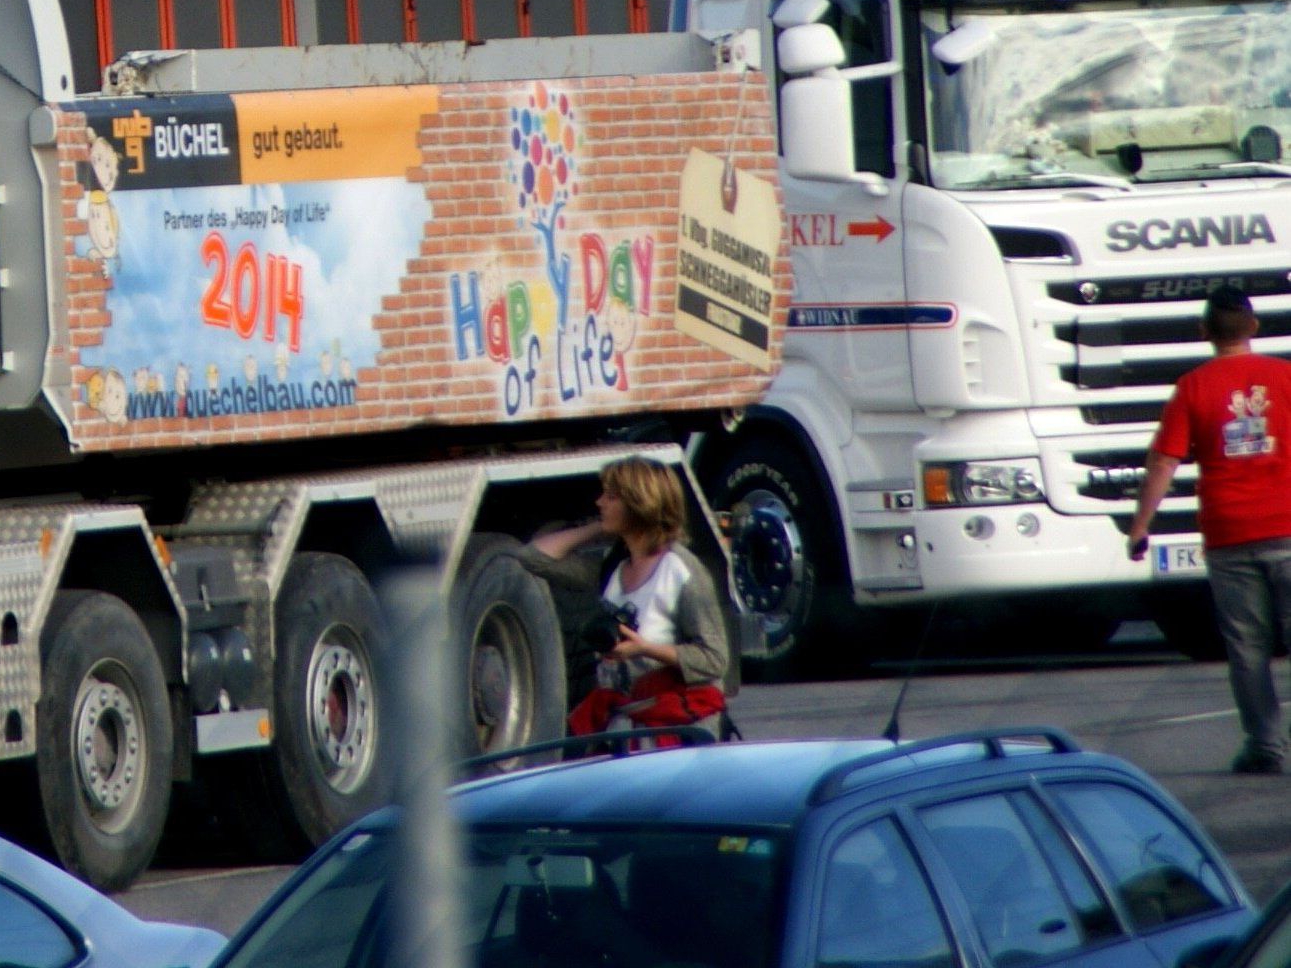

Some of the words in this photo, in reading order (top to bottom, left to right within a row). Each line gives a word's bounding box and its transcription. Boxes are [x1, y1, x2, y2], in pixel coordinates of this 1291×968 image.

[154, 116, 230, 159] BÜCHEL
[252, 128, 280, 159] gut
[284, 121, 344, 158] gebaut.
[163, 210, 204, 230] Partner
[207, 208, 228, 228] des
[271, 204, 290, 226] Day
[293, 203, 303, 223] of
[790, 213, 844, 247] KEL
[1106, 212, 1277, 253] SCANIA
[200, 230, 304, 354] 2014
[504, 334, 541, 416] of
[557, 313, 618, 402] Life
[126, 375, 358, 420] wwwbuechelbau.com
[1176, 548, 1198, 569] FK
